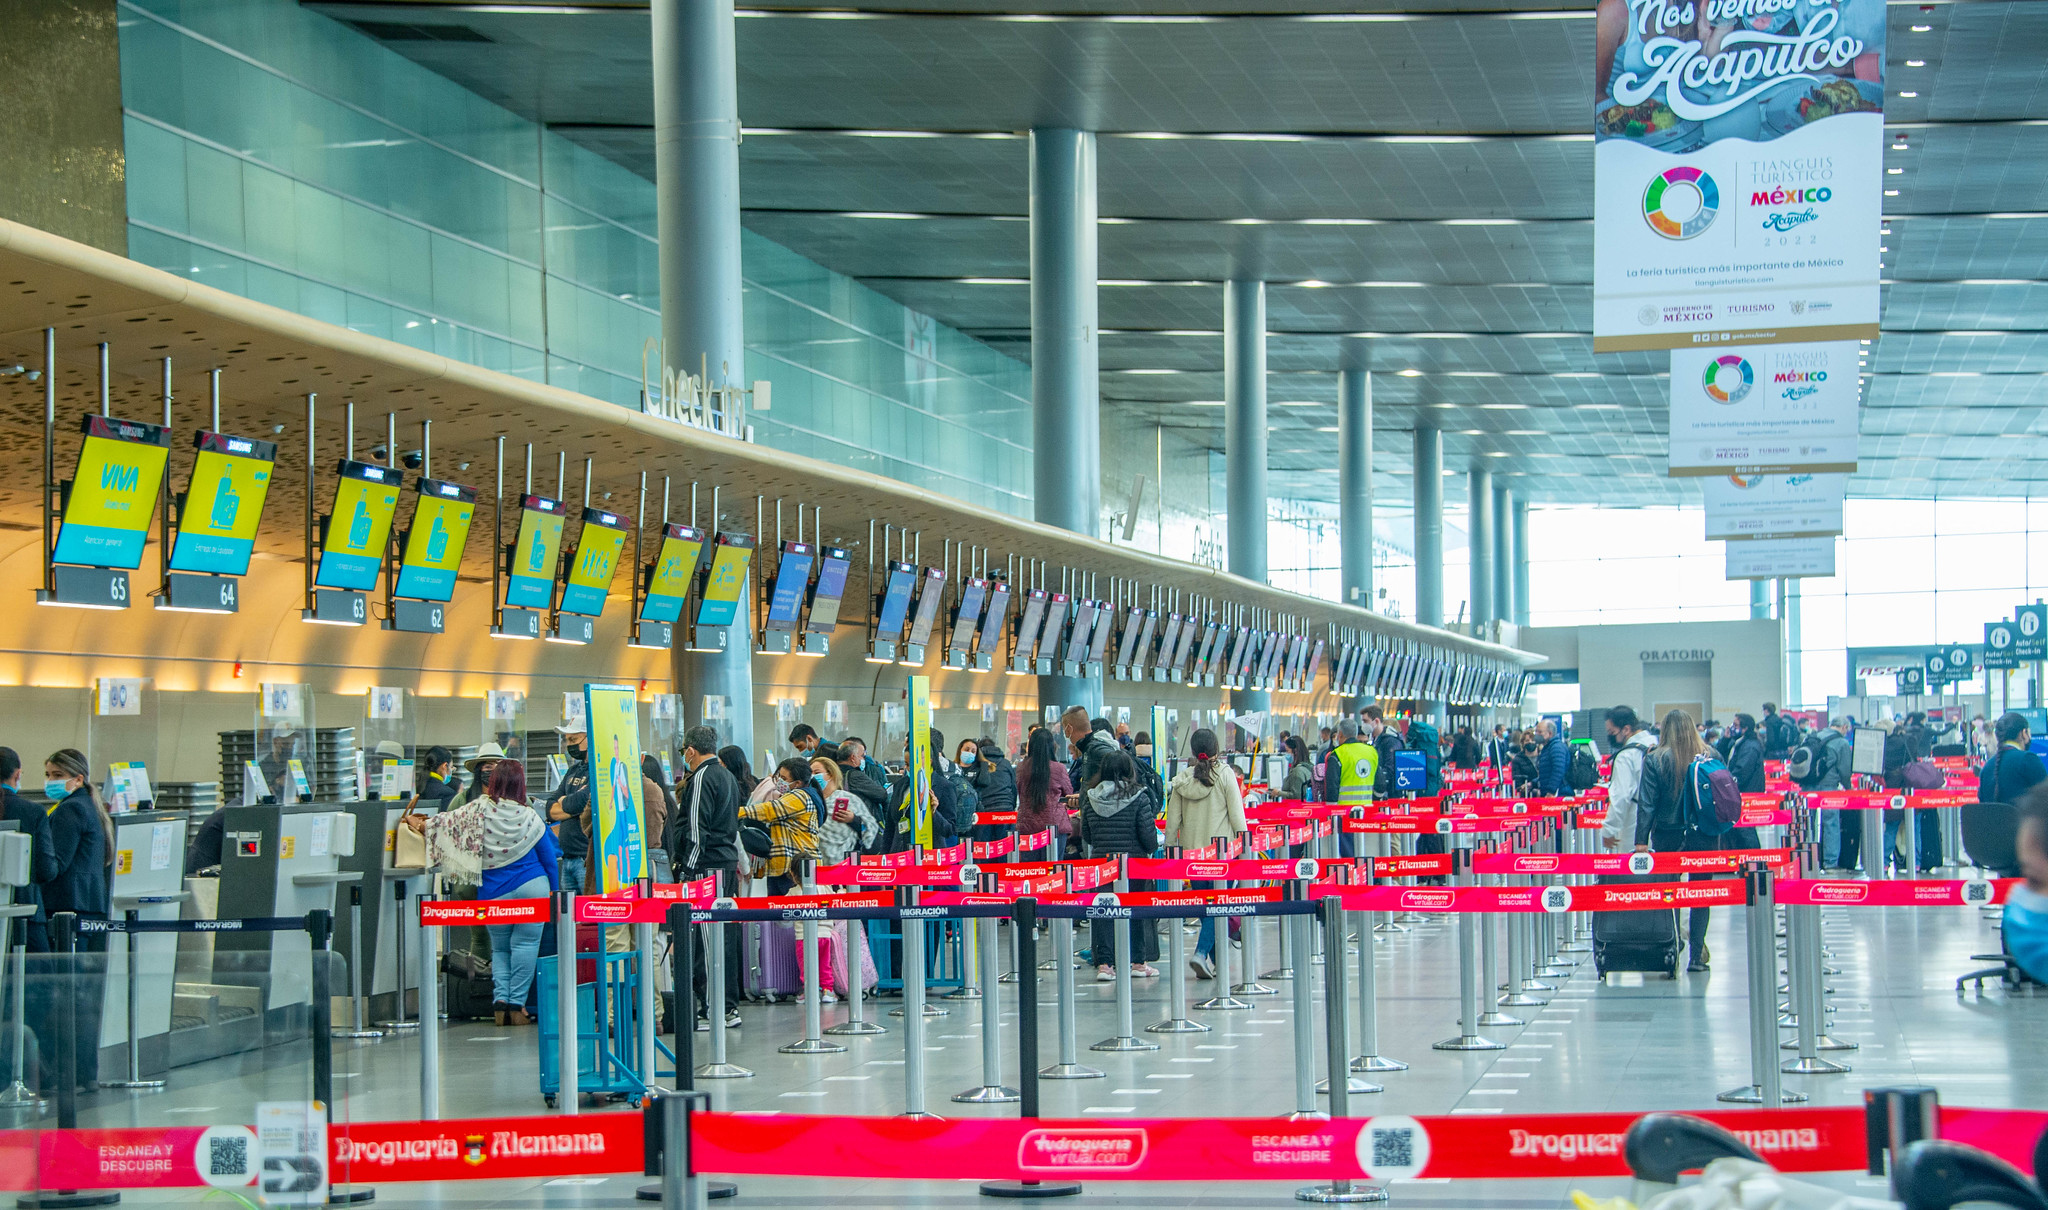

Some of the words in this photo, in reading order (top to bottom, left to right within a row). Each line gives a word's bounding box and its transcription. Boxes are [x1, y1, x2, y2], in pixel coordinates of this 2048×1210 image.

[1613, 8, 1863, 121] Acapulco
[1751, 157, 1832, 173] TIANGUIS
[1762, 207, 1819, 232] Acapulco
[1626, 269, 1638, 278] La
[1639, 267, 1663, 277] feria
[1708, 264, 1731, 273] más
[1733, 260, 1790, 273] importante
[1792, 259, 1806, 269] de
[1807, 257, 1844, 268] México
[1727, 303, 1776, 314] TURISMO
[1663, 311, 1714, 322] MÉXICO
[642, 336, 717, 431] Check
[721, 360, 745, 440] in
[119, 424, 145, 438] SAMSUNG
[101, 462, 139, 493] VIVA
[110, 577, 126, 600] 65
[220, 584, 235, 606] 64
[353, 598, 364, 619] 63
[431, 608, 442, 628] 62
[529, 615, 538, 634] 61
[584, 620, 592, 640] 60
[663, 627, 671, 644] 59
[719, 631, 727, 648] 58
[1640, 649, 1715, 661] ORATORIO
[1398, 860, 1439, 869] Alemana
[1680, 856, 1726, 867] Droguería
[1005, 866, 1046, 878] Droguería
[1217, 894, 1266, 904] Alemana
[1605, 890, 1661, 903] Droguería
[1676, 887, 1729, 899] Alemana
[832, 899, 879, 908] Alemana
[1206, 905, 1256, 915] MIGRACIÓN
[423, 906, 475, 919] Droguería
[487, 905, 535, 917] Alemana
[782, 909, 828, 919] BIOMIG
[900, 906, 948, 917] MIGRACIÓN
[1086, 907, 1132, 917] BIOMIG
[335, 1134, 459, 1165] Droguería
[491, 1131, 606, 1157] Alemana
[1252, 1135, 1320, 1147] ESCANEA
[1321, 1135, 1334, 1147] Y
[1509, 1129, 1625, 1161] Droguer
[1734, 1128, 1818, 1151] mana
[100, 1145, 162, 1157] ESCANEA
[165, 1144, 174, 1156] Y
[1253, 1150, 1331, 1163] DESCUBRE
[100, 1158, 173, 1172] DESCUBRE
[1050, 1152, 1128, 1165] virtual.com
